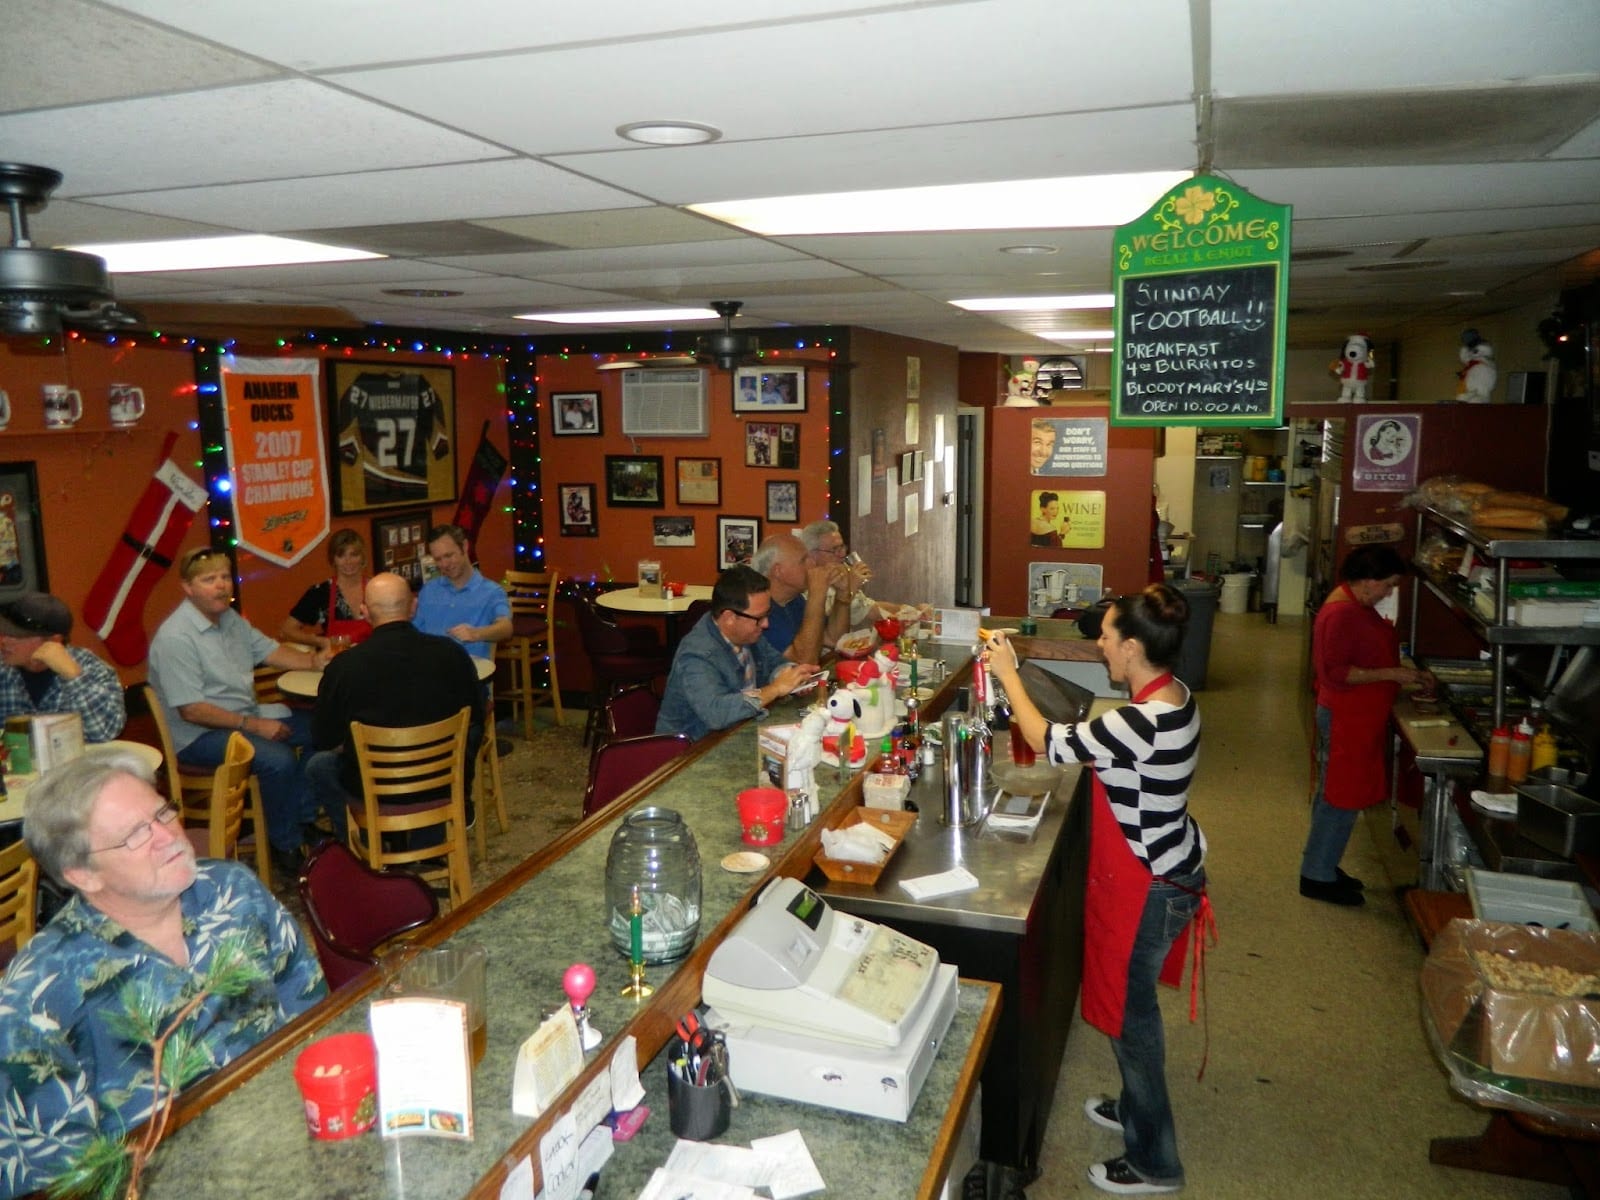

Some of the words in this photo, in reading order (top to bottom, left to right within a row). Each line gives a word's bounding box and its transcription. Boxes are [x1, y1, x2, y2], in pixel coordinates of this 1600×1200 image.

[1132, 219, 1266, 252] WELCOME
[1144, 250, 1187, 266] RELAX
[1136, 283, 1231, 307] SUNDAY
[1126, 342, 1220, 359] BREAKFAST
[1155, 358, 1256, 374] BURRITOS
[243, 381, 300, 399] ANAHEIM
[1126, 381, 1185, 397] BLOODY
[251, 403, 294, 422] DUCKS
[1142, 400, 1178, 413] OPEN
[254, 430, 302, 460] 2007
[376, 417, 417, 468] 27
[241, 461, 291, 484] STANLEY
[292, 459, 314, 478] CUP
[1364, 473, 1407, 481] BITCH
[244, 480, 315, 506] CHAMPIONS
